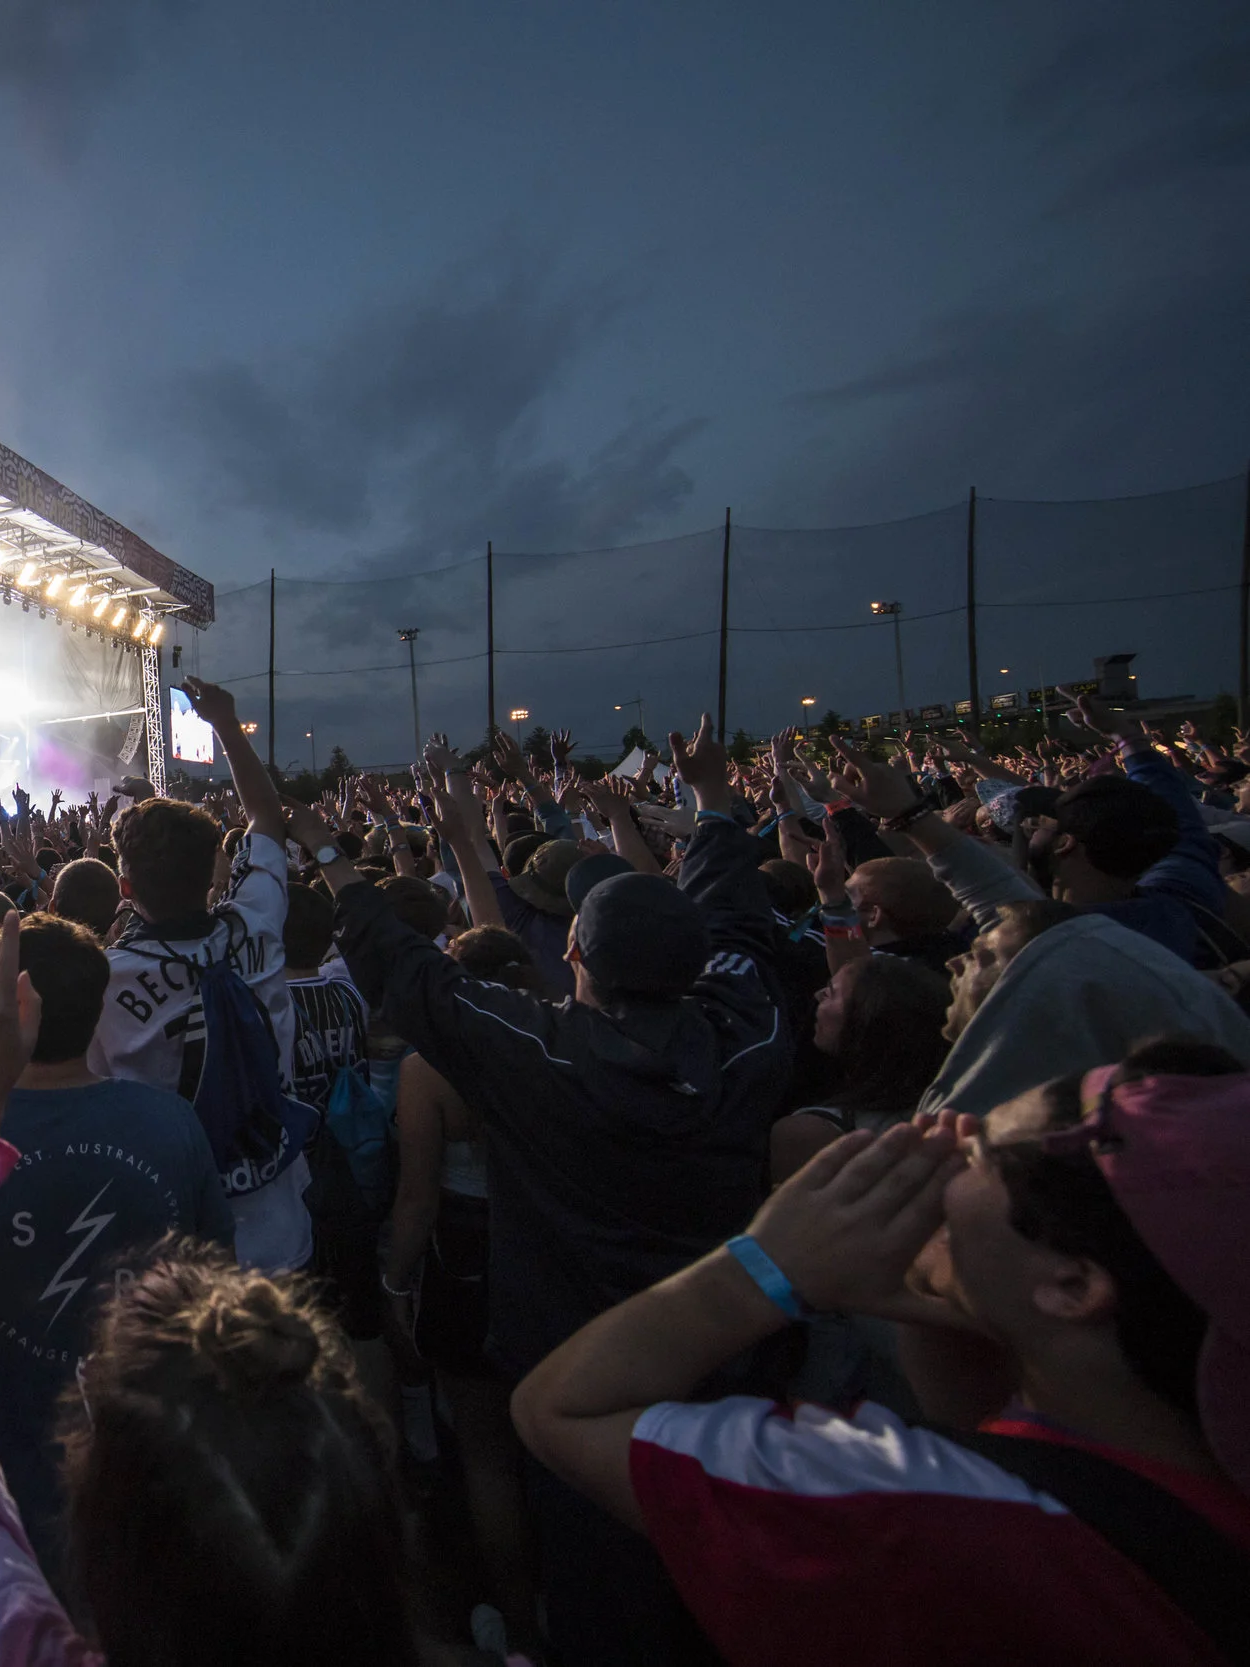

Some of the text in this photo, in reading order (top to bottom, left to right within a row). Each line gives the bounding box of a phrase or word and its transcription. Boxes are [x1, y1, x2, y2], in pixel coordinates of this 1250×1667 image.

[116, 936, 264, 1023] BECKAM
[65, 1143, 159, 1185] AUSTRALIA
[12, 1211, 36, 1247] S
